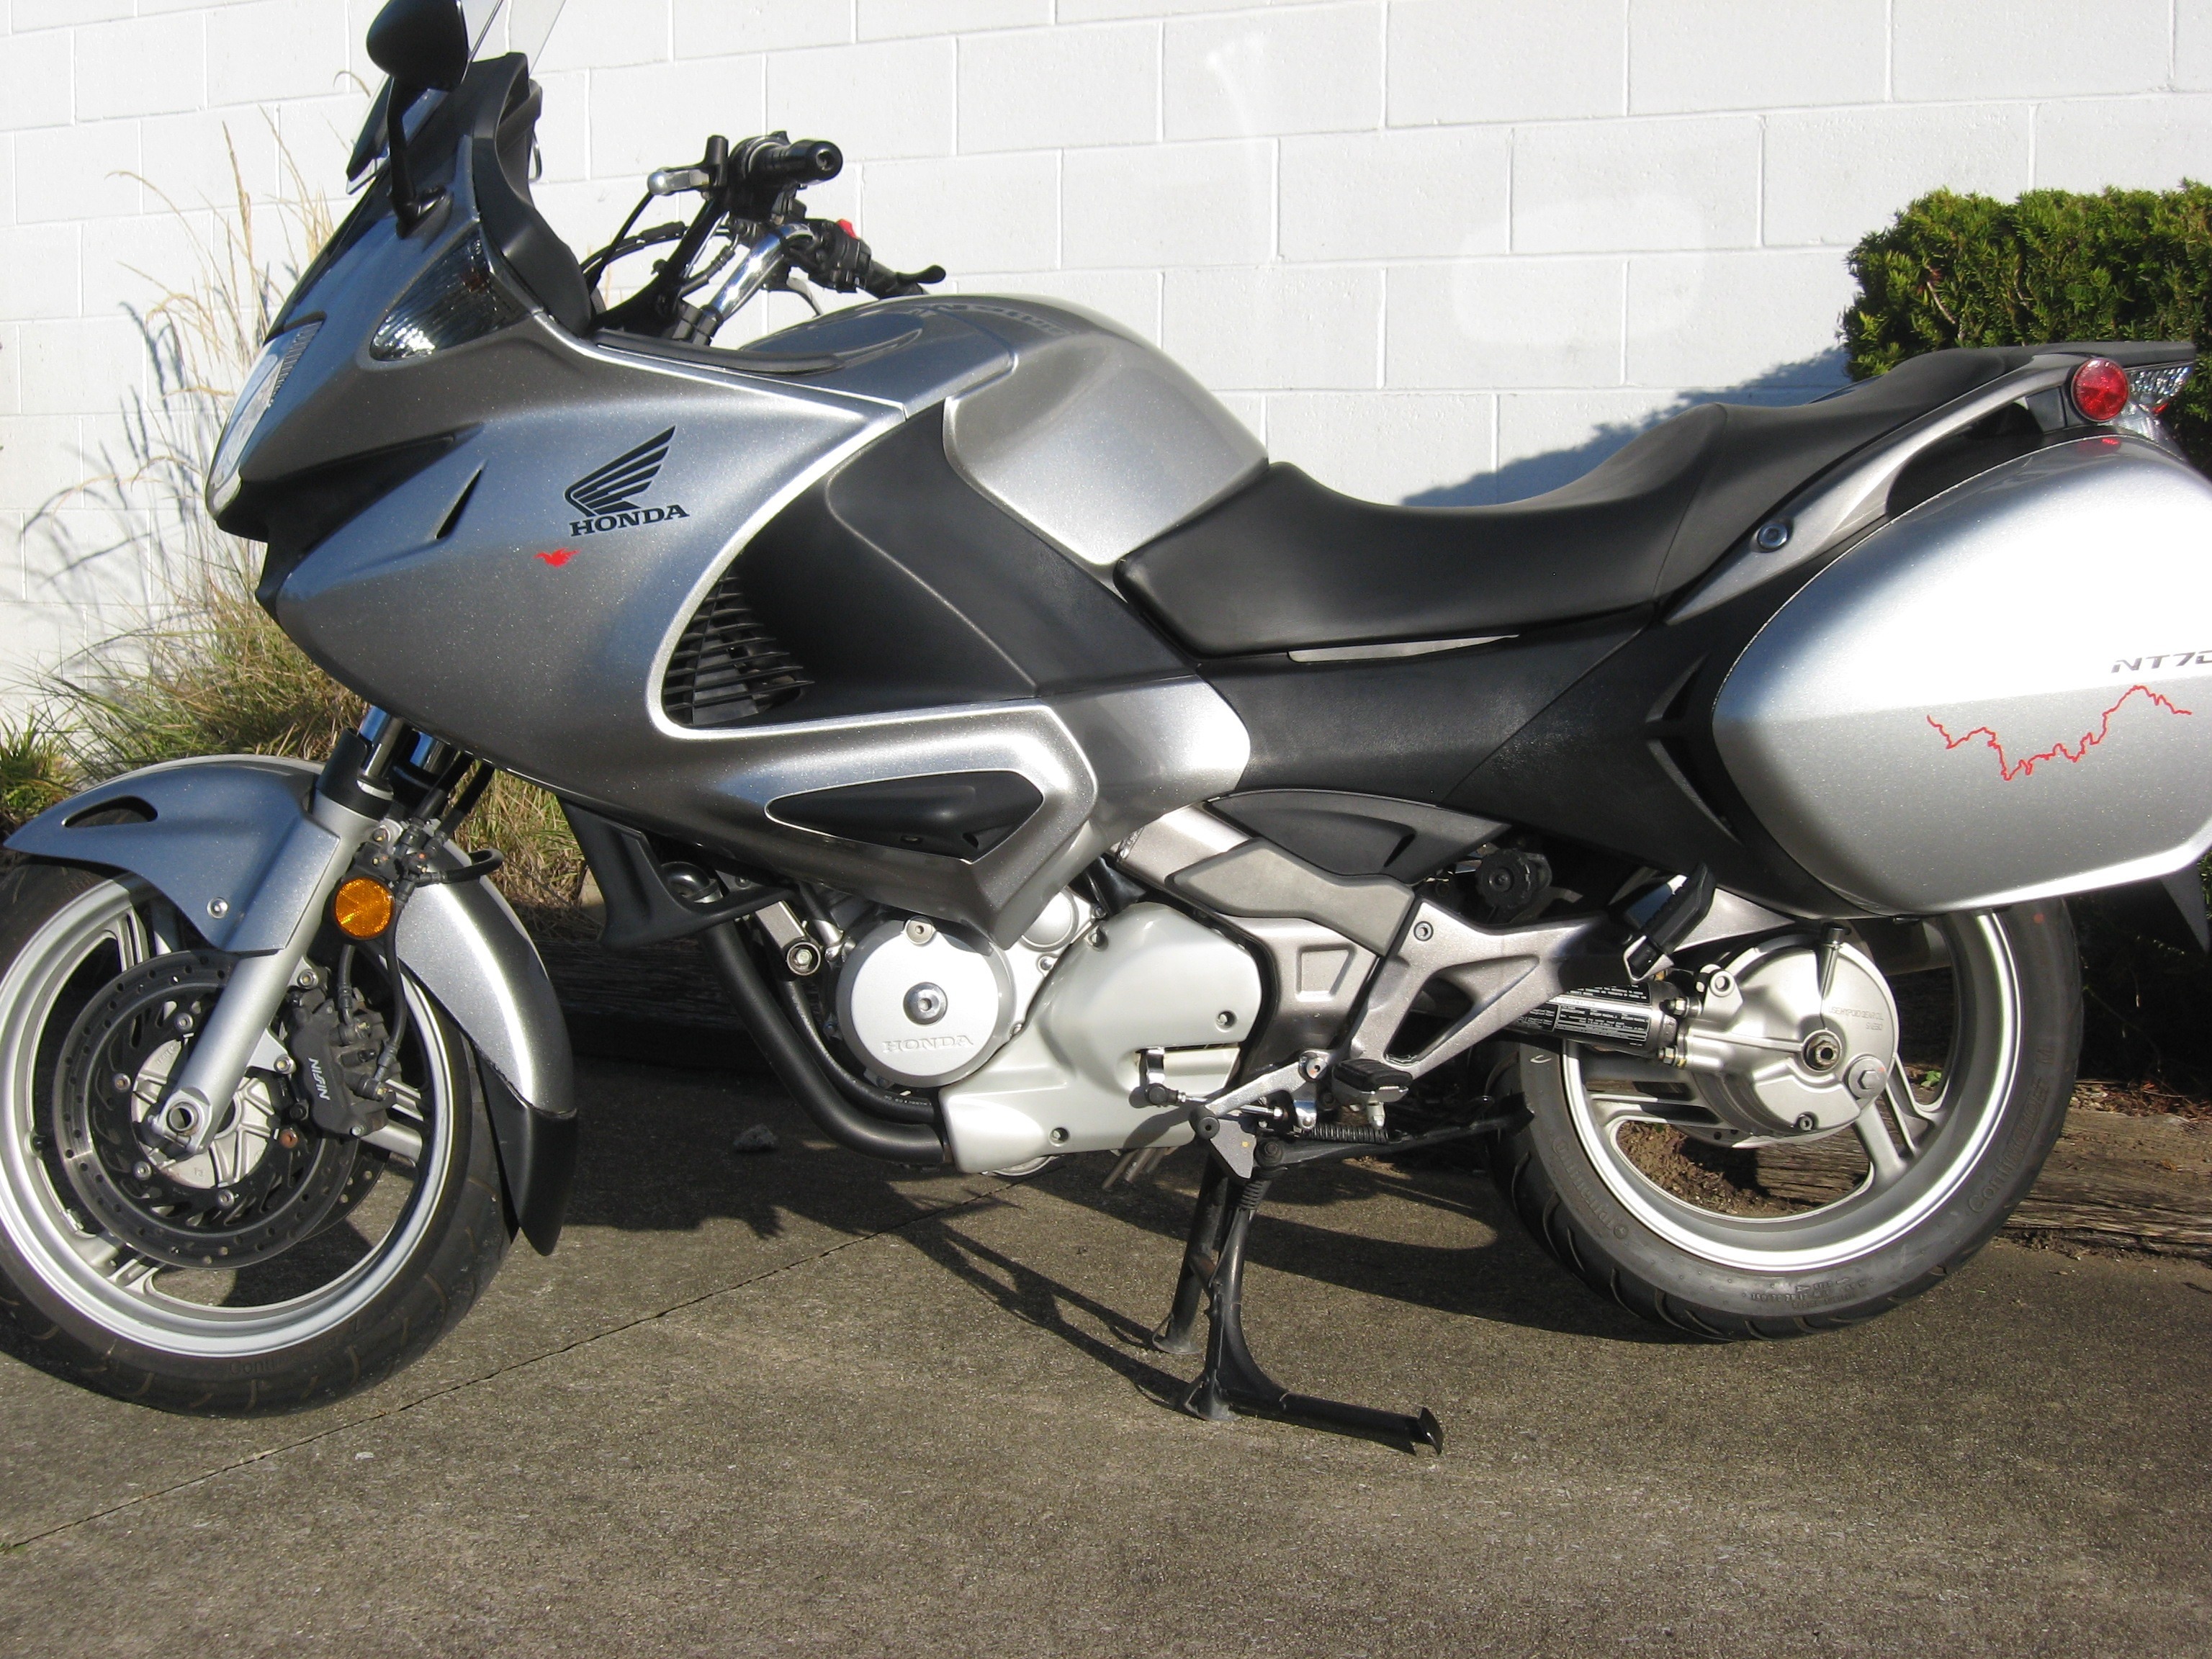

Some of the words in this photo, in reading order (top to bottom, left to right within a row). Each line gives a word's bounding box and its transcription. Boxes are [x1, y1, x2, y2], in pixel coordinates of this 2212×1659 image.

[569, 504, 690, 536] HONDA
[882, 1035, 974, 1054] HONDA
[308, 1057, 331, 1101] NISSIN
